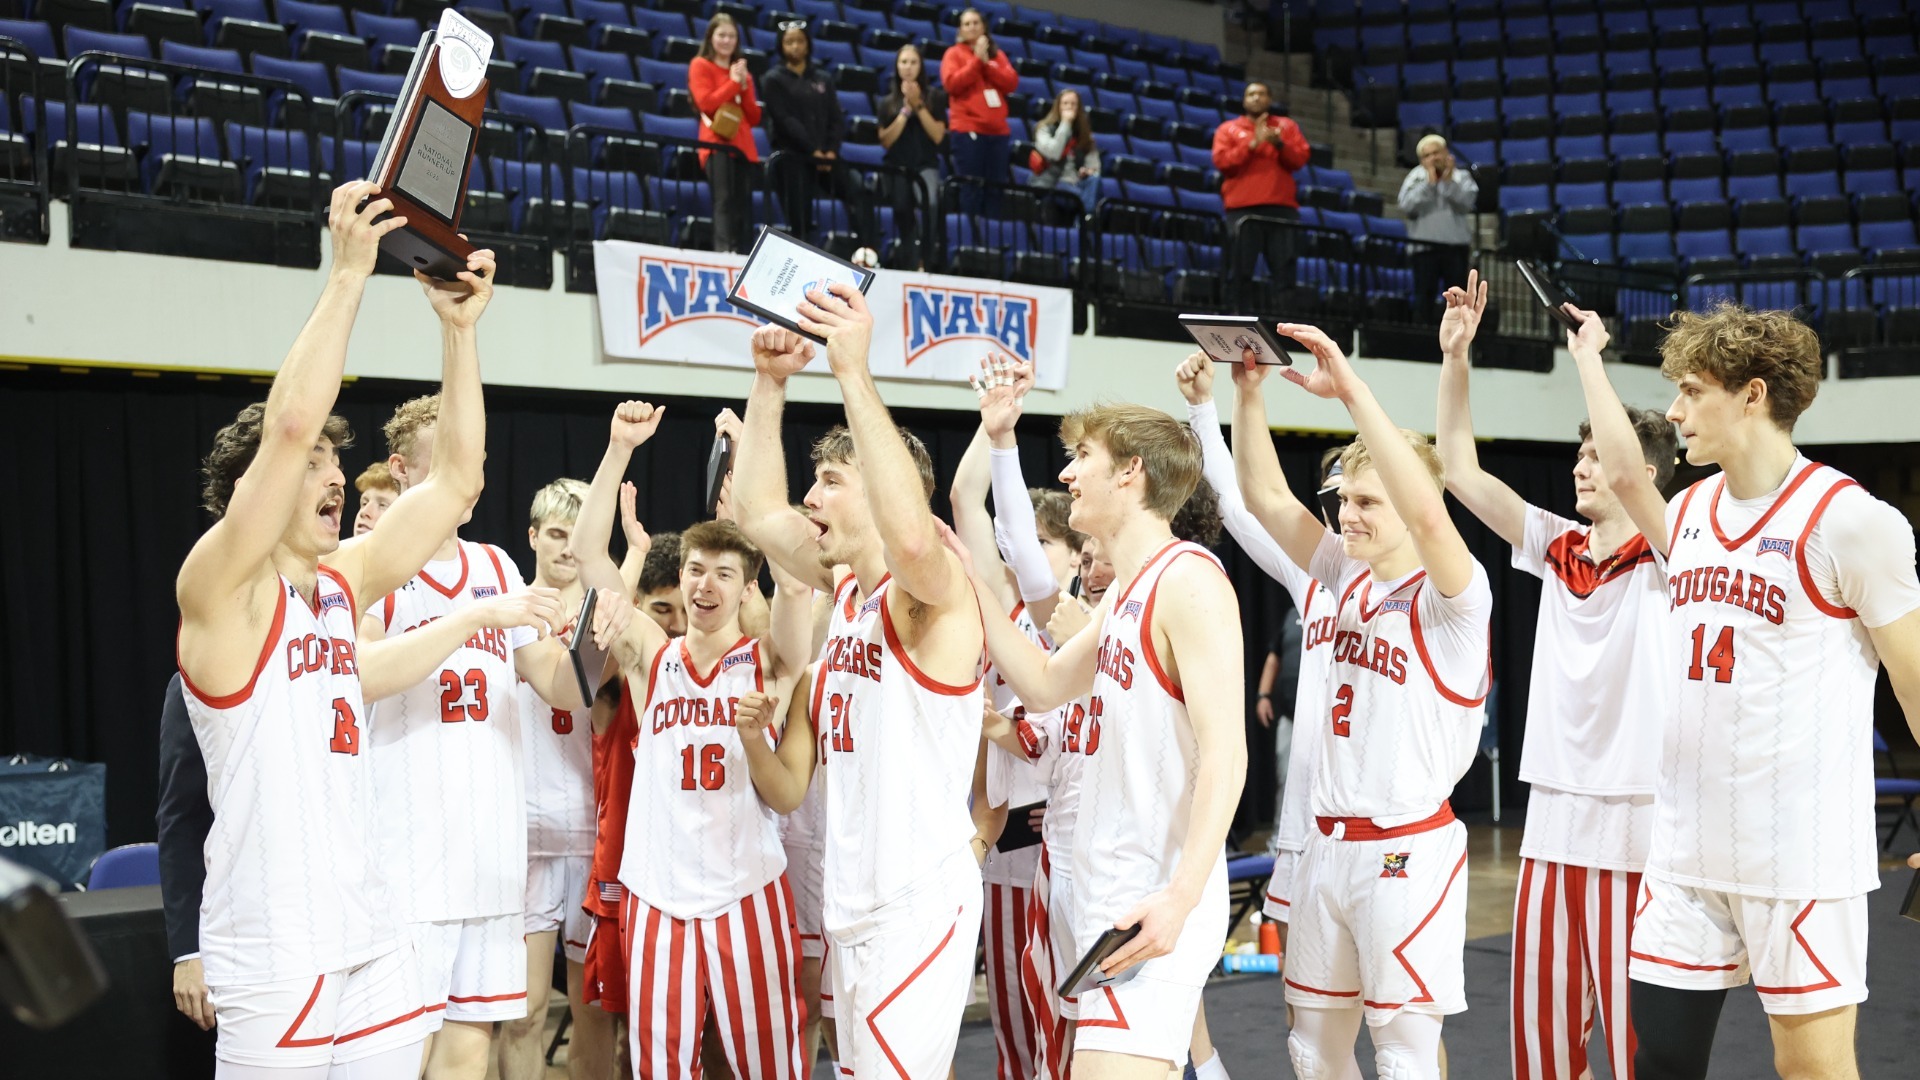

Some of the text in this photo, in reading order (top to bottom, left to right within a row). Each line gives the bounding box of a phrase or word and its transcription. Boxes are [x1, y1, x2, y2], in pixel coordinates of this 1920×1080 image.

[417, 149, 455, 177] RUNNER-UP
[423, 144, 453, 168] NATIONAL
[771, 257, 793, 296] RUNNER-UP
[778, 264, 799, 295] NATIONAL
[908, 290, 1030, 361] NAIA
[1759, 539, 1790, 556] NAIA
[321, 594, 346, 612] NAIA
[473, 586, 497, 599] NAIA
[1383, 600, 1410, 614] NAIA
[1668, 566, 1786, 626] COUGARS
[723, 653, 753, 669] NAIA
[1688, 623, 1735, 684] 14
[440, 668, 489, 723] 23
[1331, 683, 1354, 738] 2
[829, 692, 855, 752] 21
[681, 743, 725, 791] 16
[0, 820, 77, 848] olten
